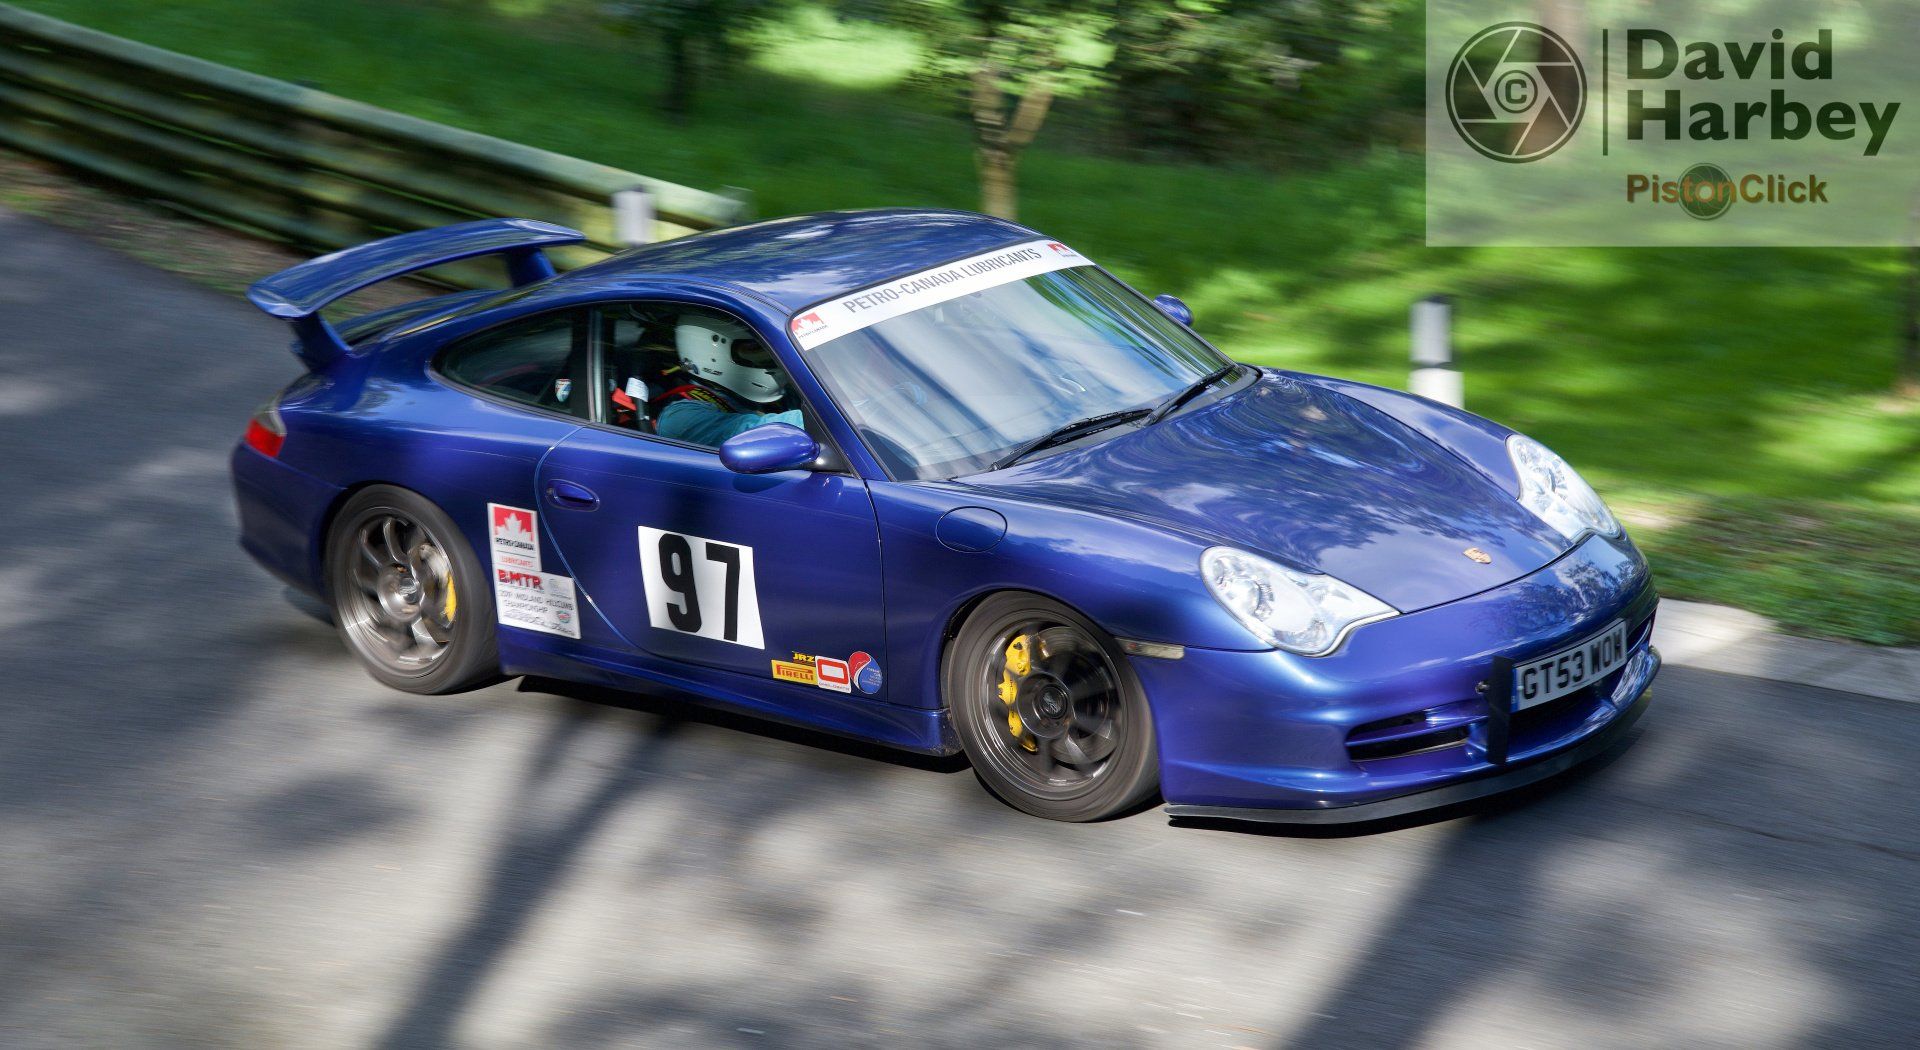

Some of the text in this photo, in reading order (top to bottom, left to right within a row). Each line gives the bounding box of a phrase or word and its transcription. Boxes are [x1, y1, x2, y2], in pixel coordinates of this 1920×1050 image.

[842, 247, 1042, 314] PETRO-CANADA LUBRICANTS
[658, 533, 740, 642] 97
[776, 664, 814, 681] PIRELLI
[1522, 649, 1585, 700] GT53
